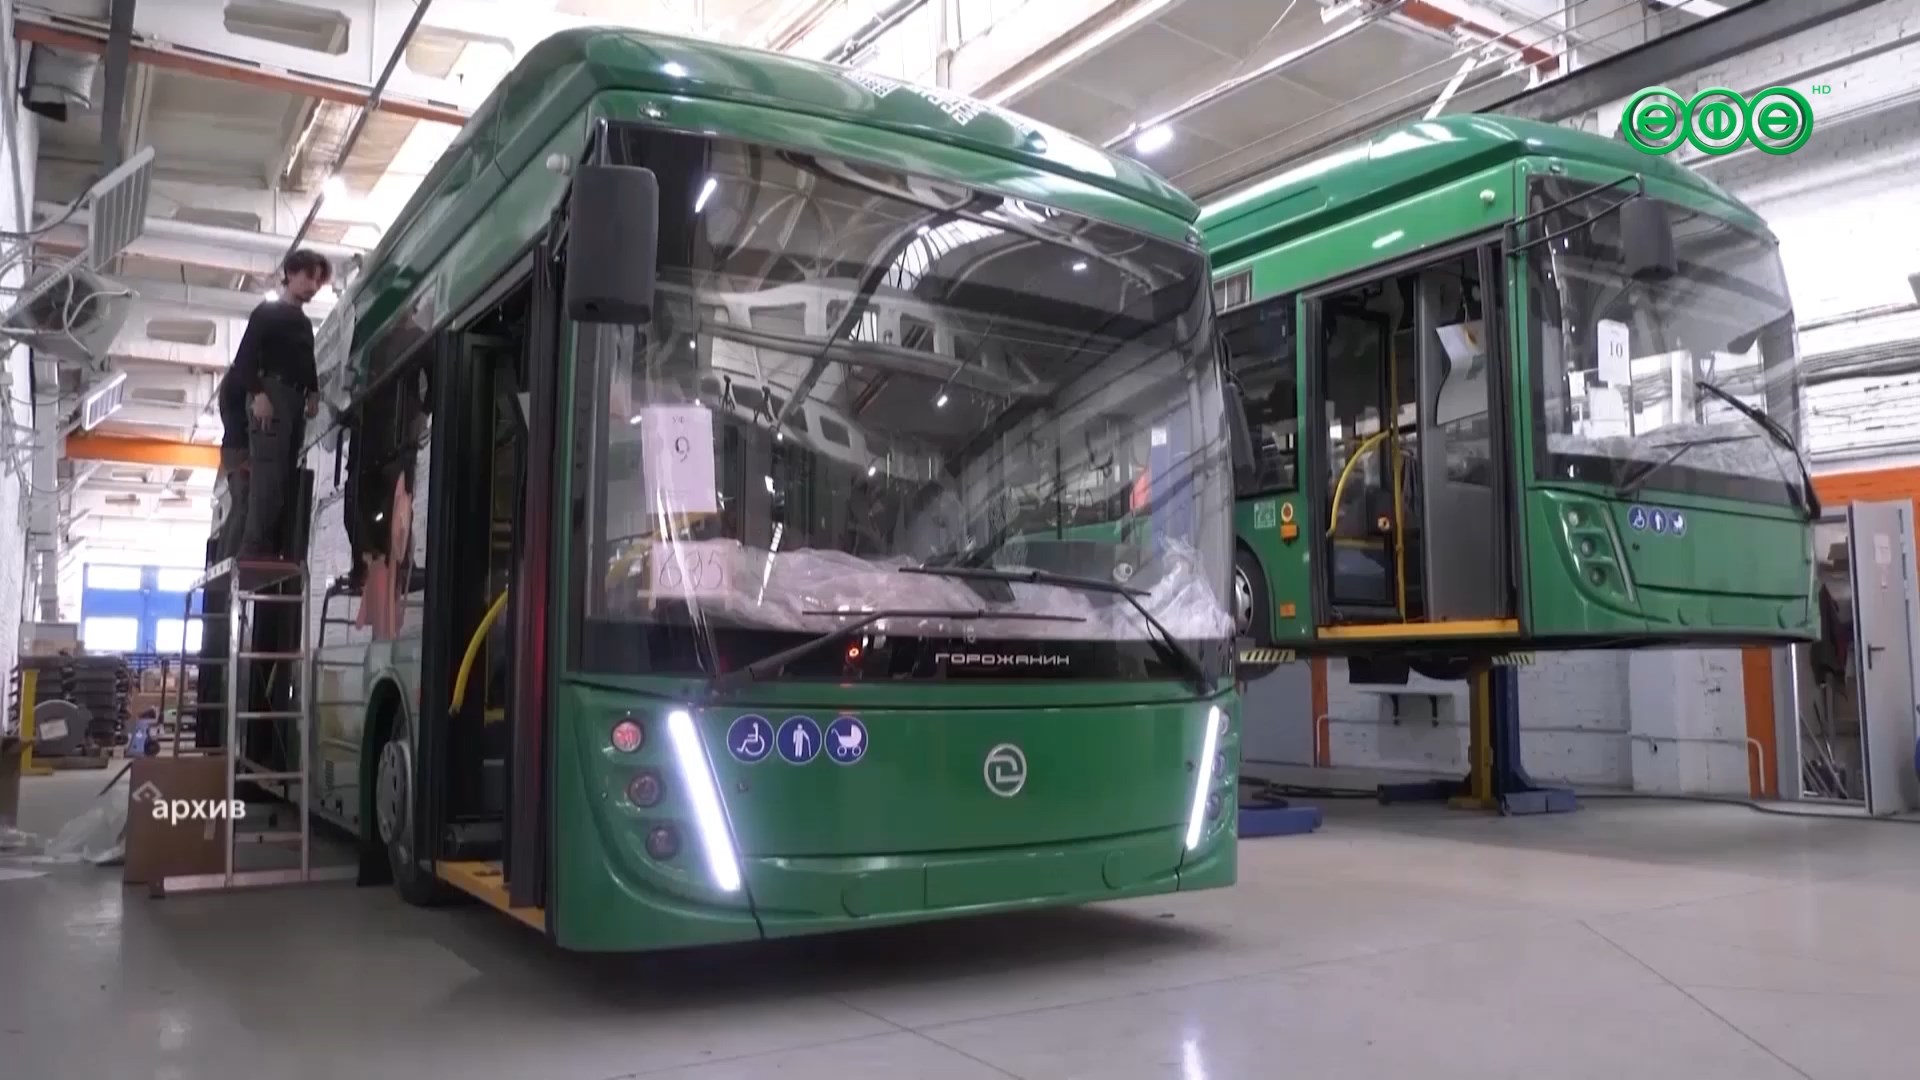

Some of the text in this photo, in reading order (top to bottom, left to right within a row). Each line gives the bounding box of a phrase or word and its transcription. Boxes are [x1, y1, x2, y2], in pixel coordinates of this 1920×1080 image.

[1609, 341, 1623, 358] 10
[675, 436, 690, 463] 9
[935, 653, 1070, 665] ГОРОЖАНИН
